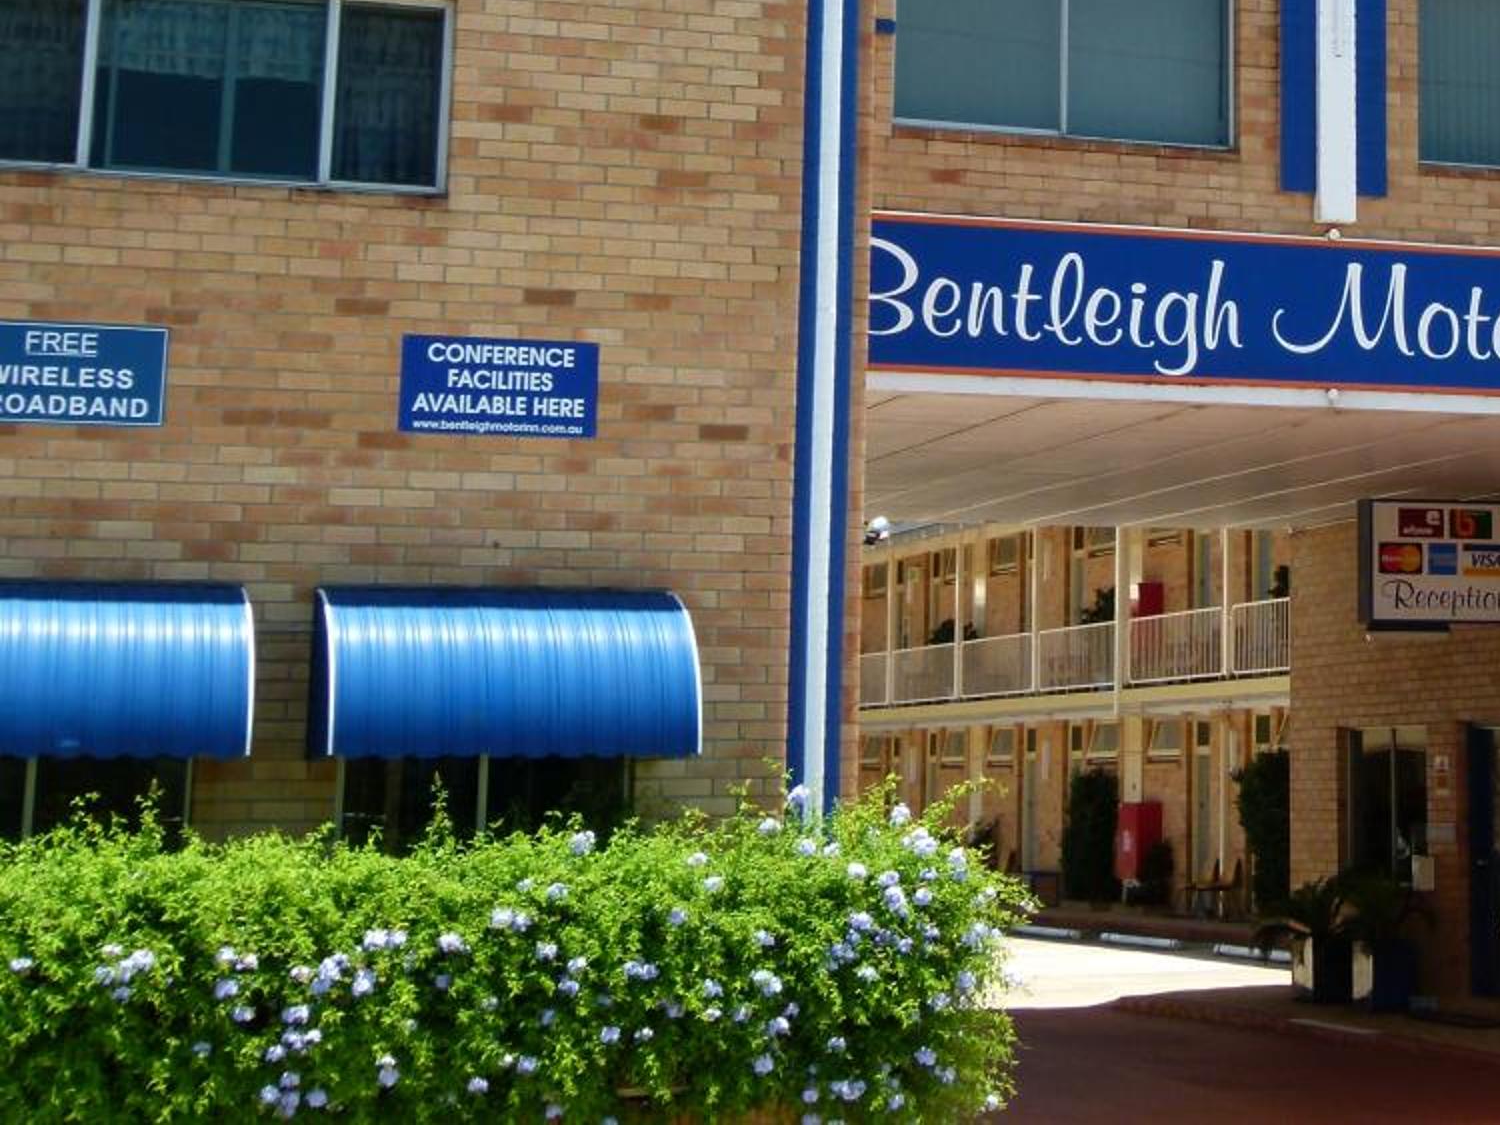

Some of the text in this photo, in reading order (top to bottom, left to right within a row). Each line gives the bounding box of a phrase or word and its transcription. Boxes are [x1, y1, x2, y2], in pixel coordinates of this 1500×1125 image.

[868, 236, 1243, 376] Bentleigh
[25, 331, 98, 356] FREE
[428, 342, 576, 368] CONFERENCE
[447, 369, 554, 392] FACILITIES
[0, 393, 149, 418] OADBAND
[411, 393, 586, 418] AVAILABLE HERE
[412, 419, 584, 435] www.bentleighmotorinn.com.au
